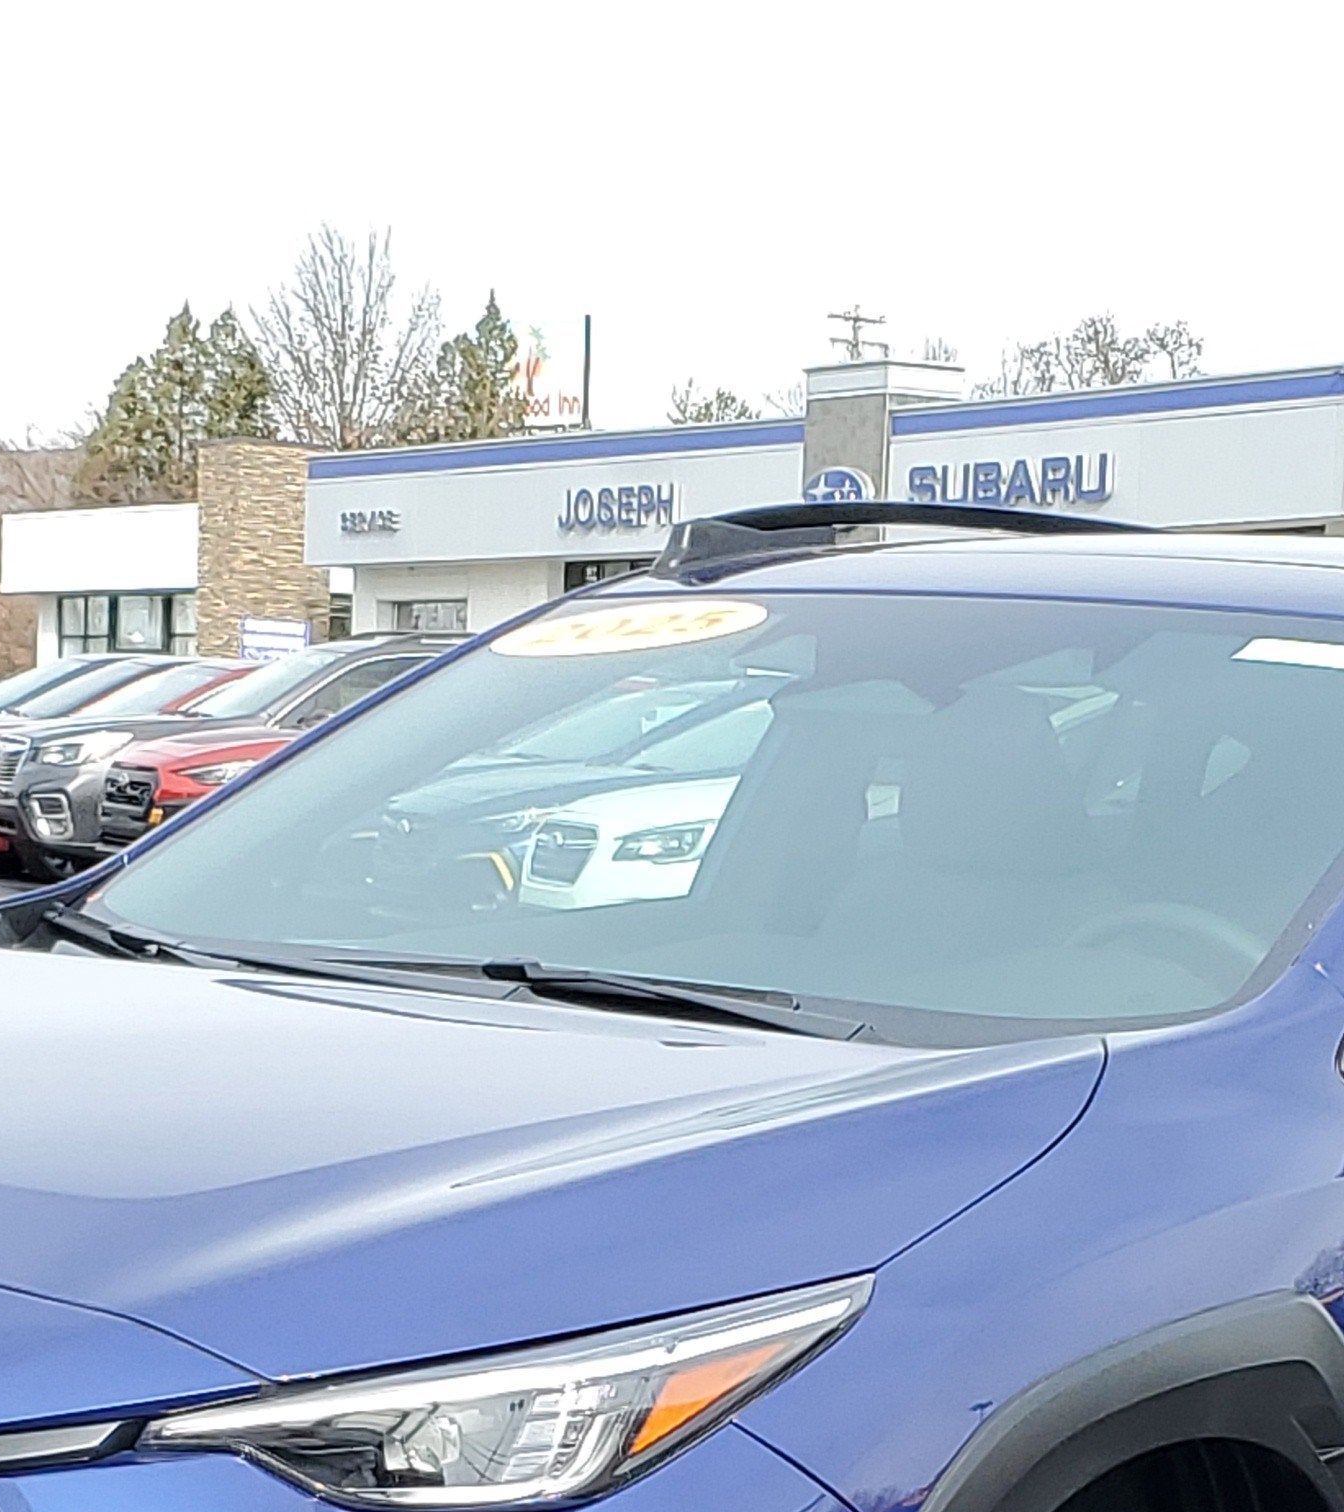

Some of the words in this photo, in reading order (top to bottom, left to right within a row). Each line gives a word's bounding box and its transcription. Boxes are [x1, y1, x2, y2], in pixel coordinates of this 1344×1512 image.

[908, 453, 1109, 506] SUBARU
[558, 482, 675, 530] JOSEPH
[525, 605, 742, 646] 2025
